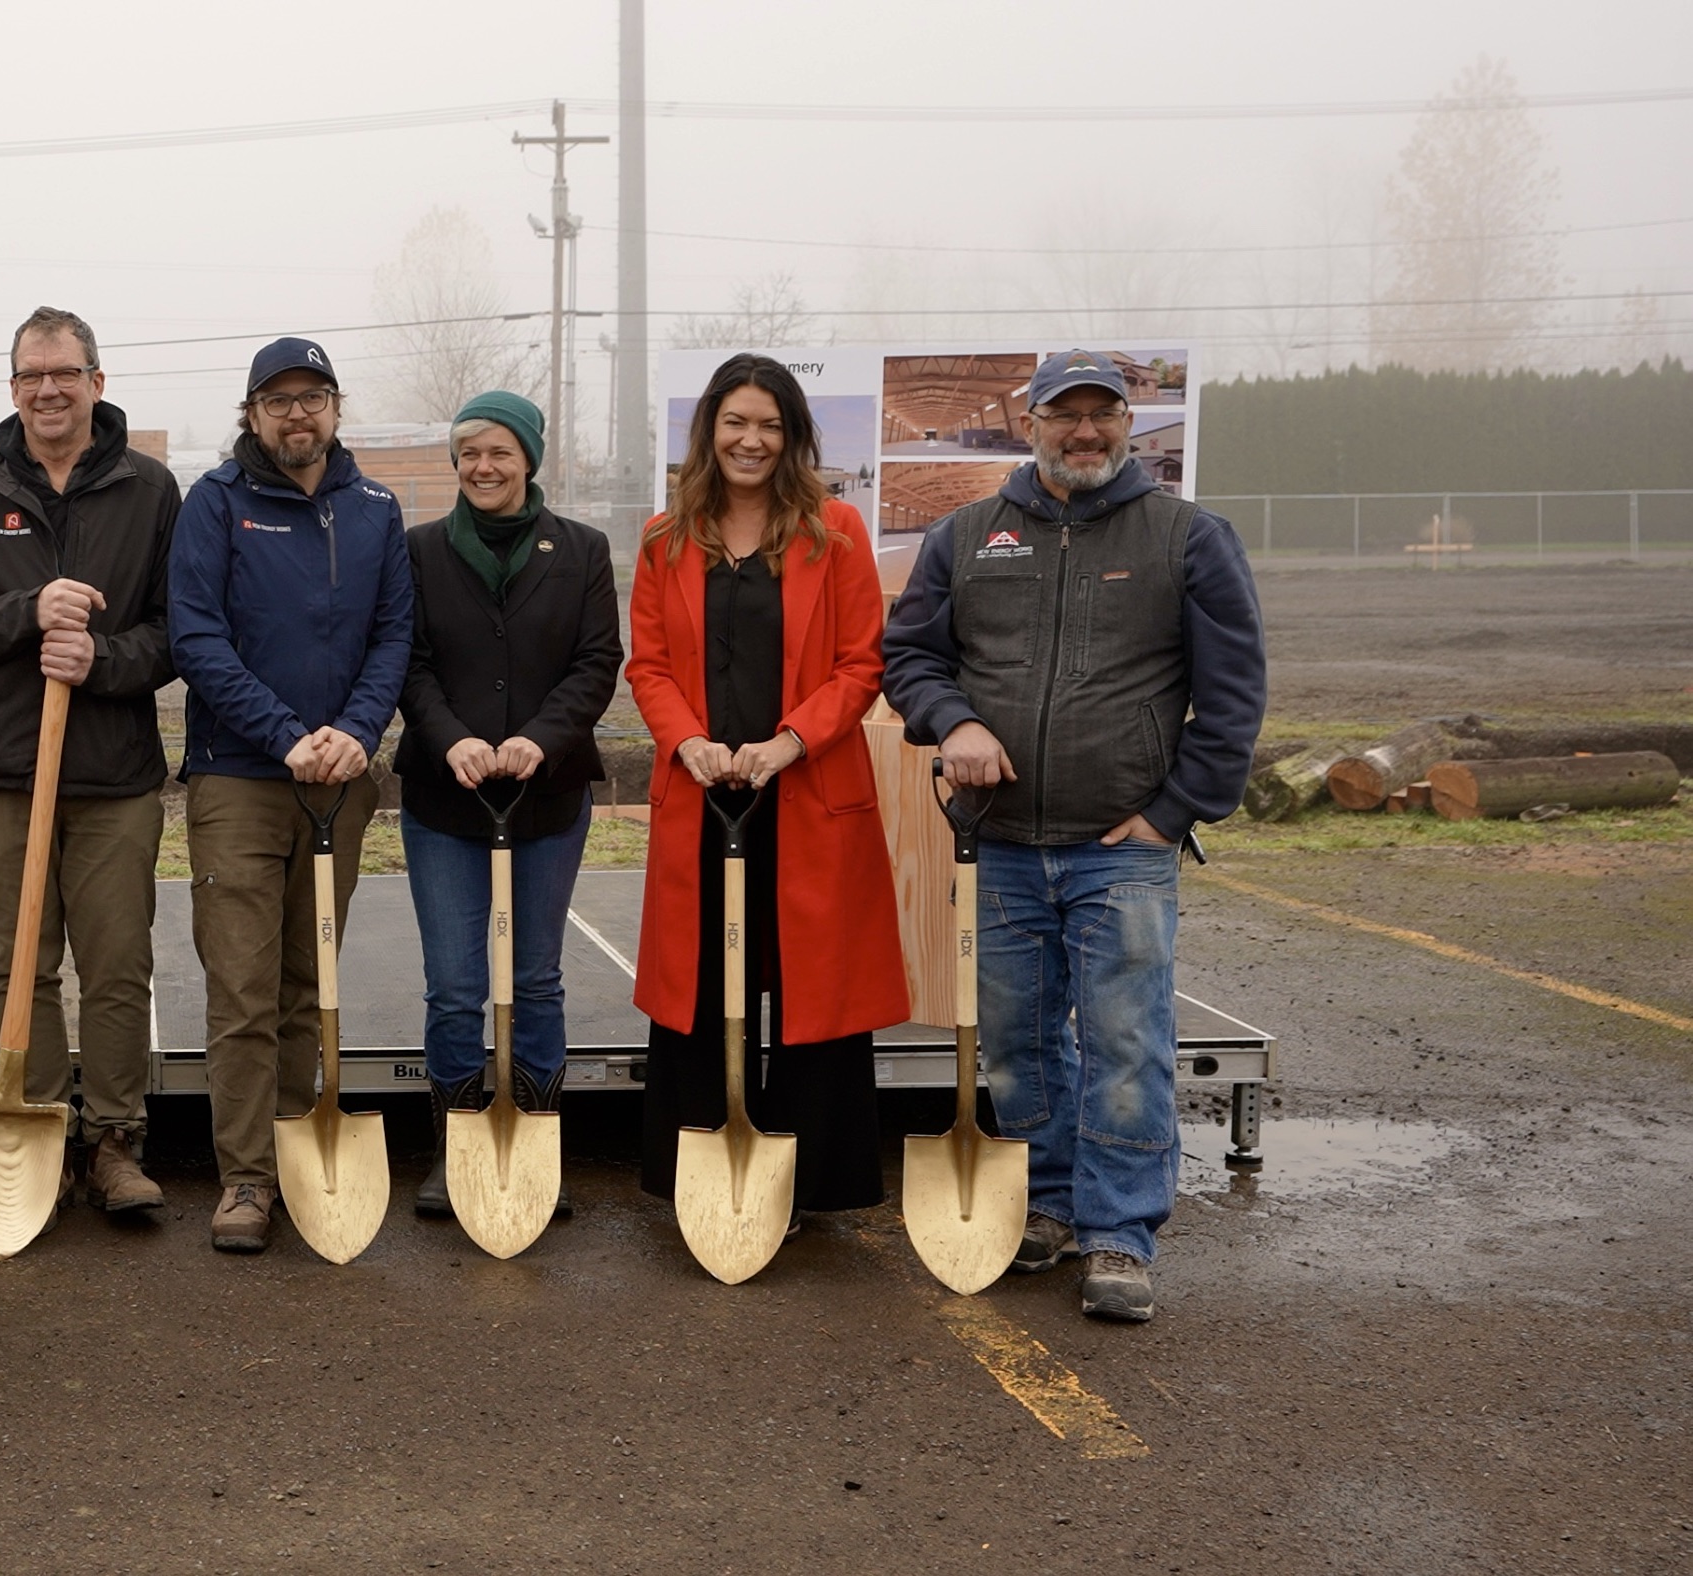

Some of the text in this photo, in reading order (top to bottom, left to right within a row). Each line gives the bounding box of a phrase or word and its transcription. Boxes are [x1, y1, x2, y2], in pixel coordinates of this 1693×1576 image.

[782, 362, 825, 377] mery
[322, 917, 332, 944] HDX
[497, 911, 507, 938] HDX
[728, 922, 738, 950] HDX
[961, 930, 972, 957] HDX
